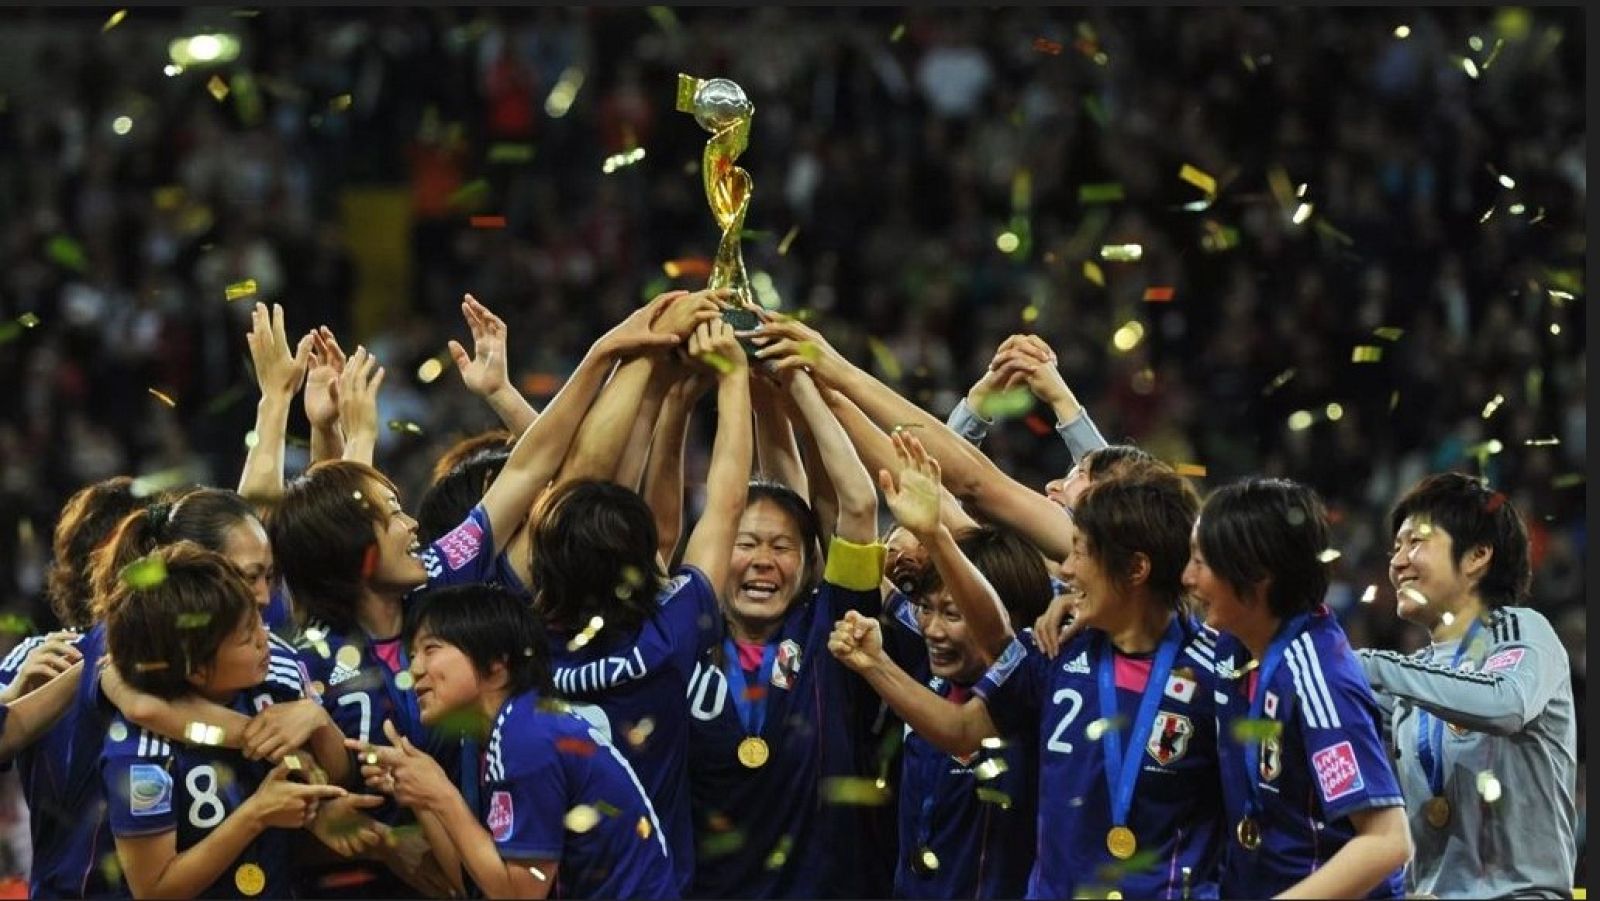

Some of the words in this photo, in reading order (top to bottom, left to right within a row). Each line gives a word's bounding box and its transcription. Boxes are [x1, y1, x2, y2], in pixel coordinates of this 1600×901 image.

[337, 691, 371, 744] 7
[1047, 688, 1083, 753] 2
[185, 765, 226, 829] 8
